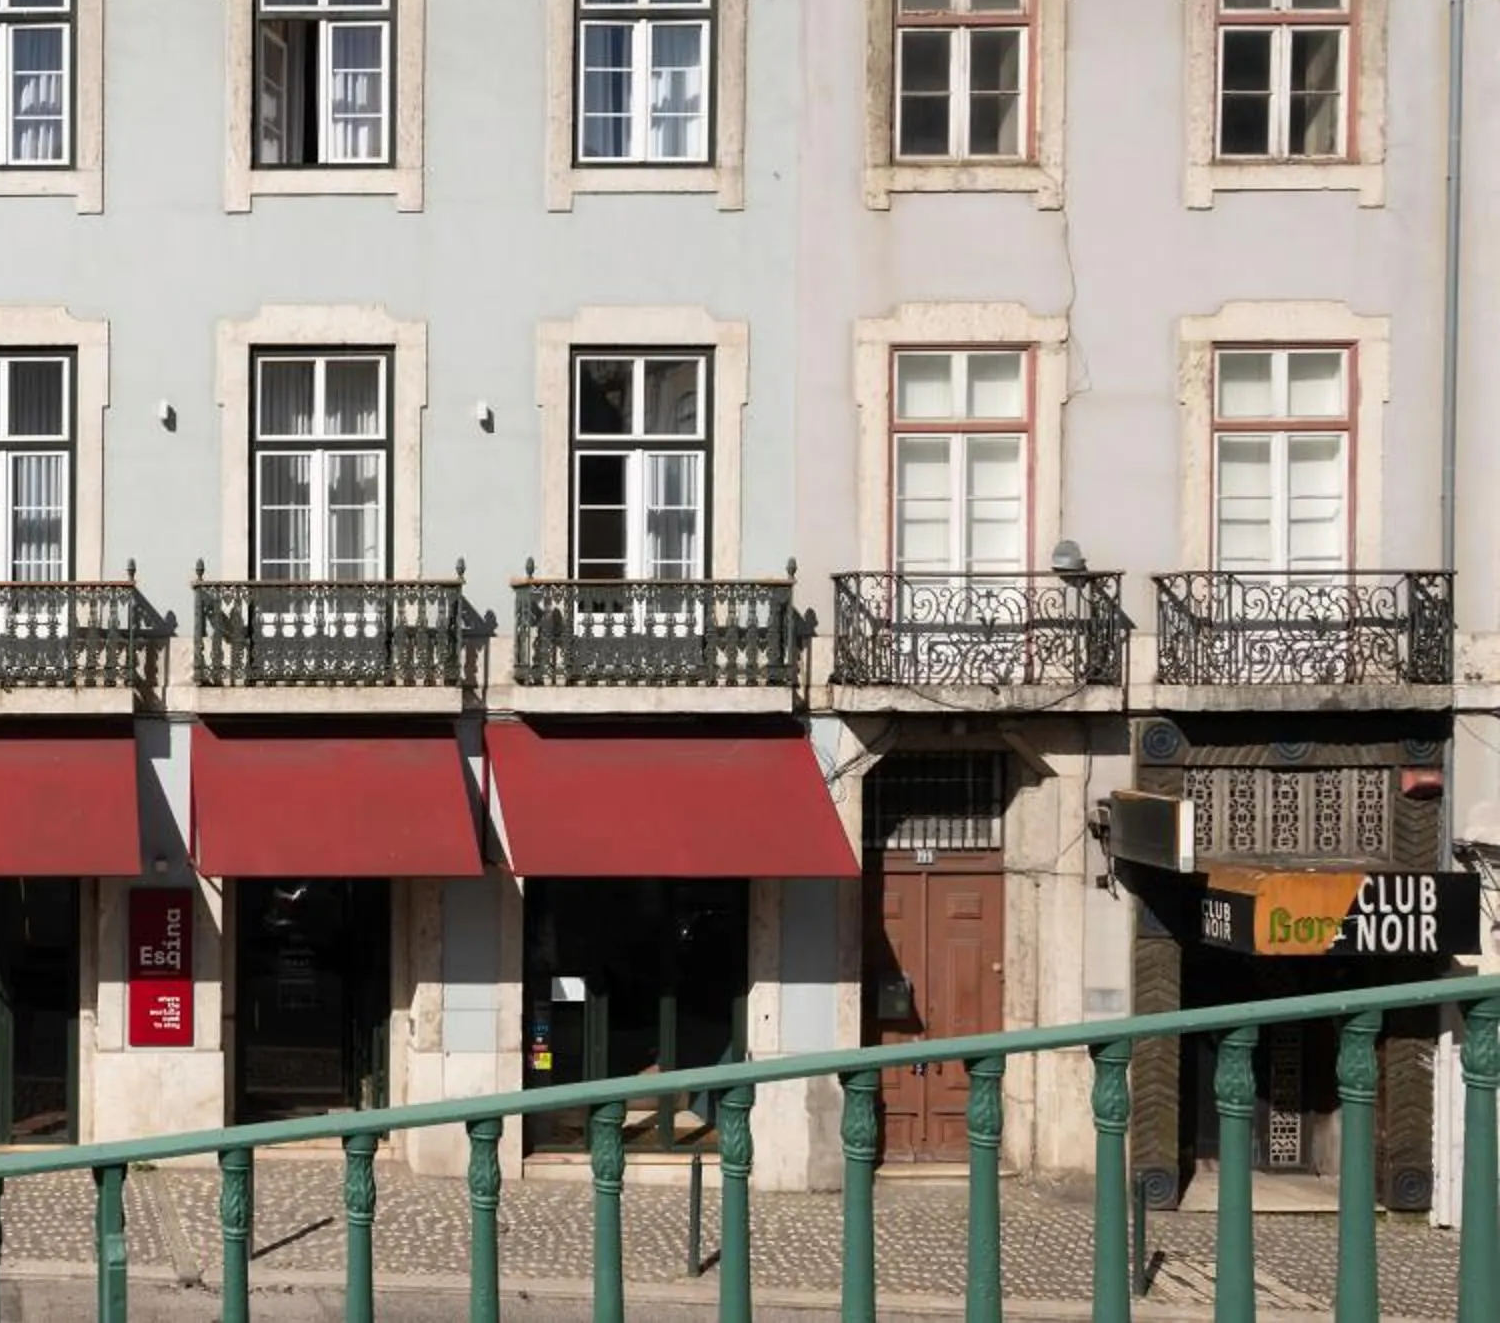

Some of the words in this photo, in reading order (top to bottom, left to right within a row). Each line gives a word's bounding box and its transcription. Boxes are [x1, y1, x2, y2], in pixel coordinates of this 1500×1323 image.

[1202, 899, 1232, 923] CLUB
[1357, 875, 1438, 915] CLUB
[1202, 916, 1232, 942] NOIR
[1356, 913, 1439, 953] NOIR
